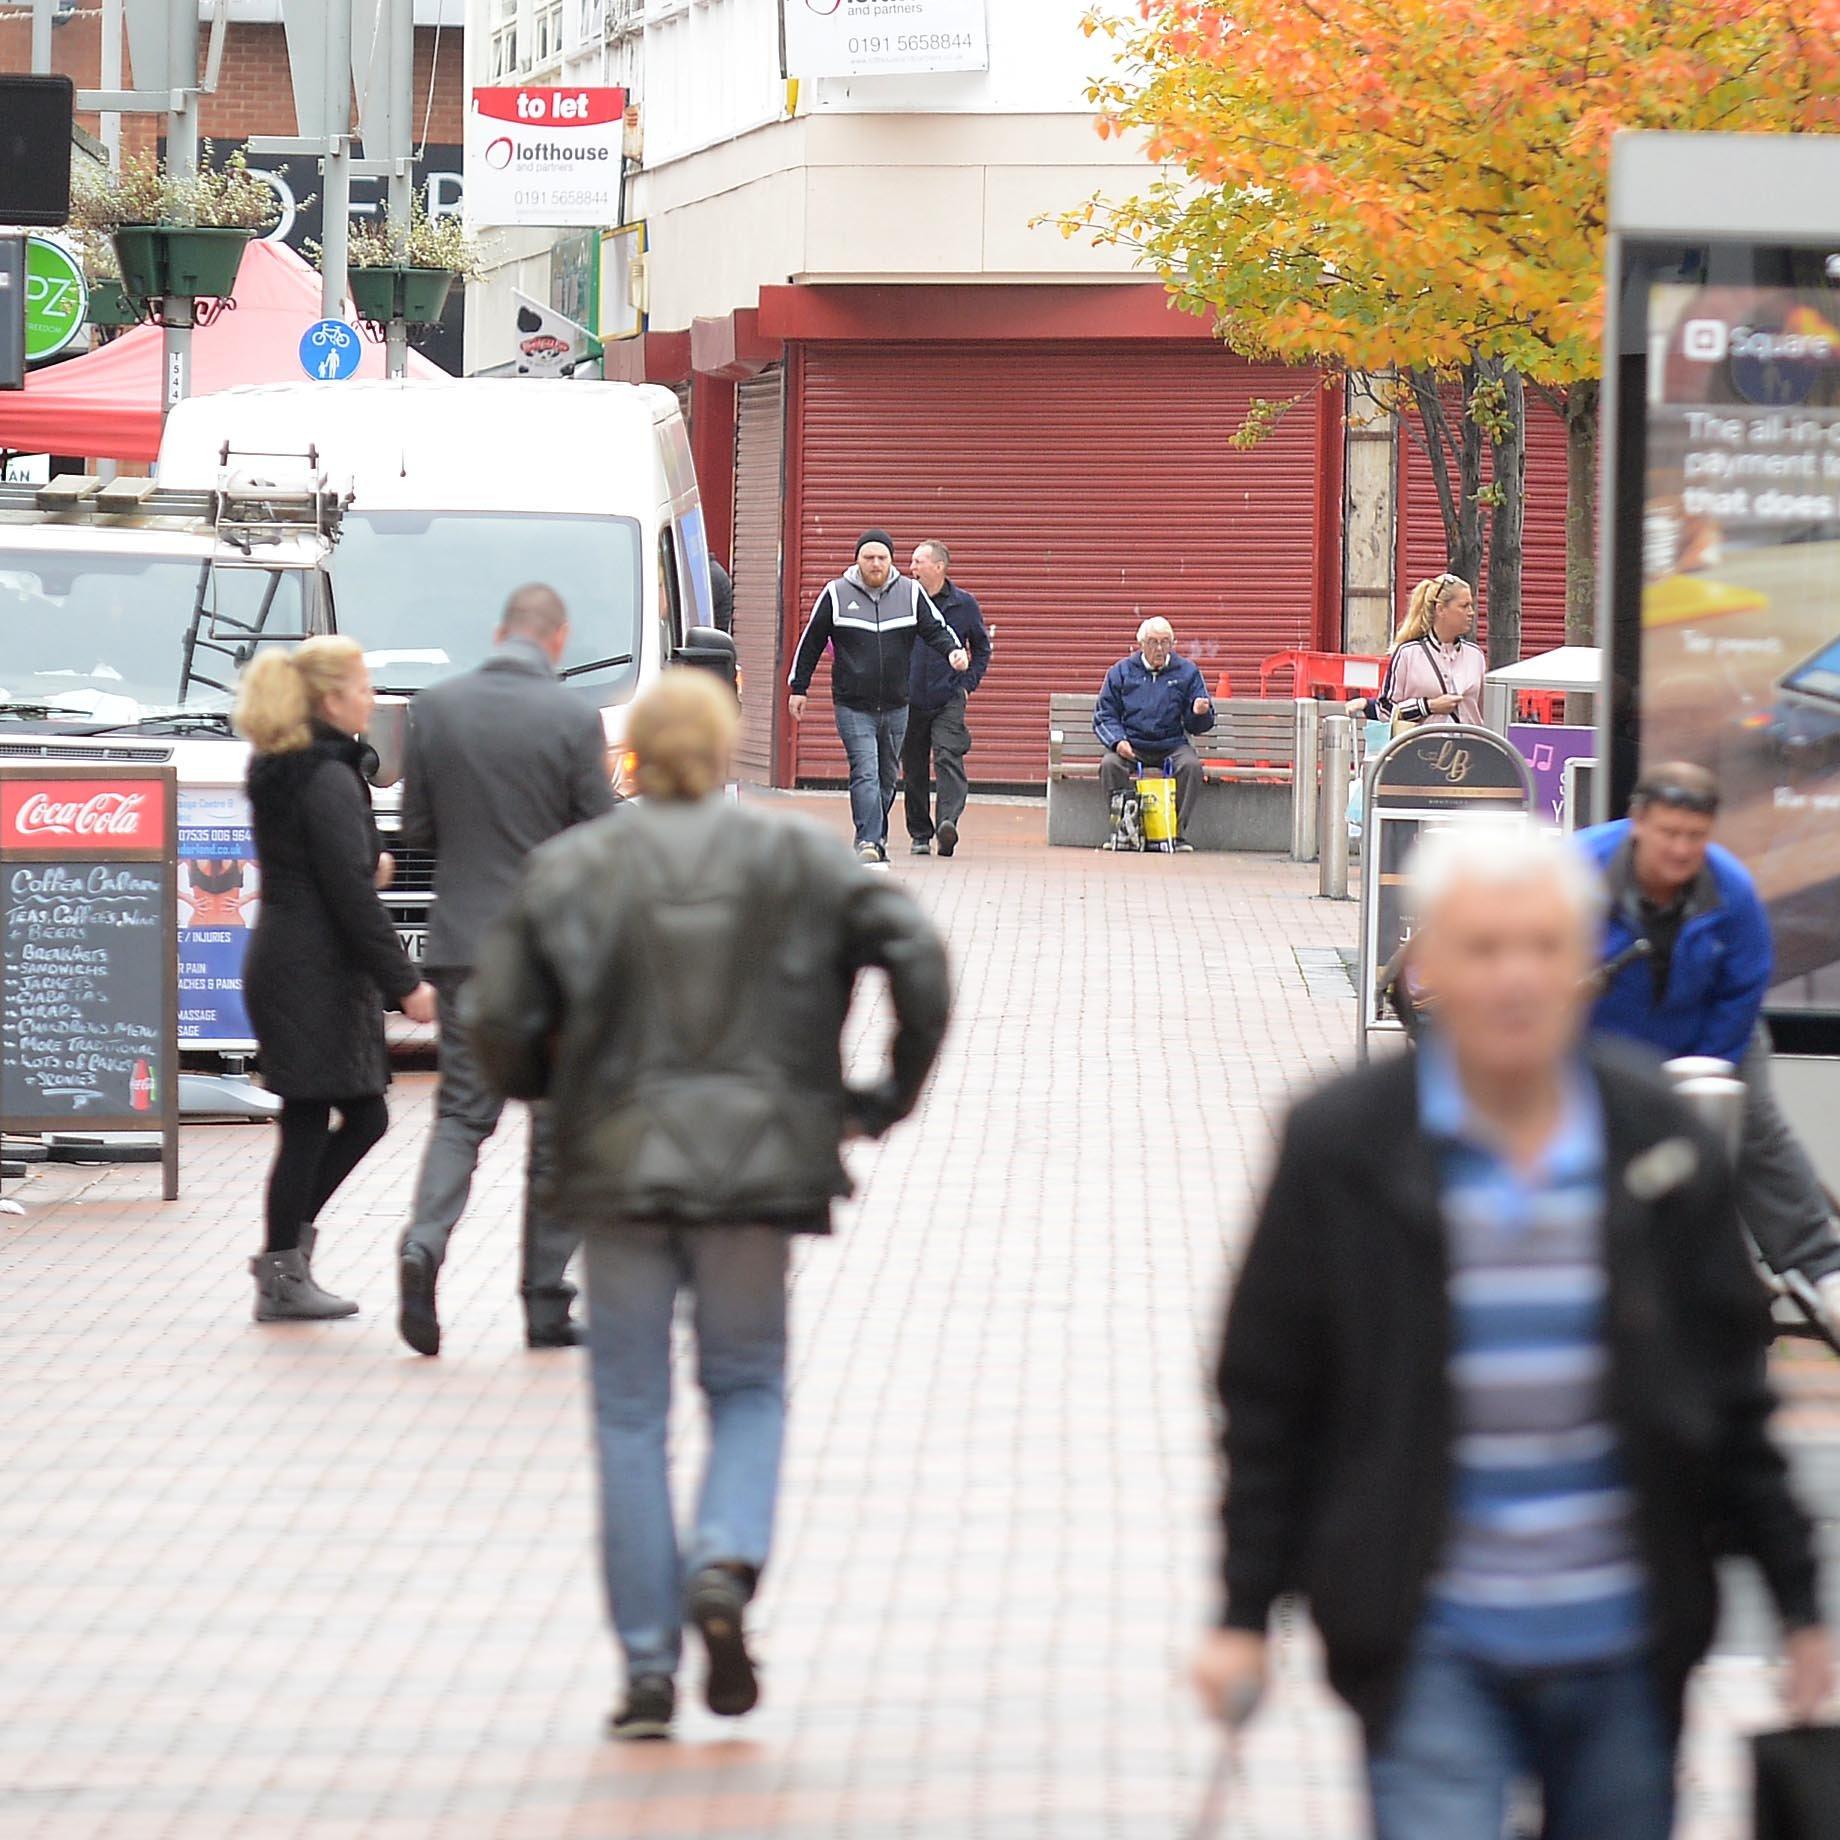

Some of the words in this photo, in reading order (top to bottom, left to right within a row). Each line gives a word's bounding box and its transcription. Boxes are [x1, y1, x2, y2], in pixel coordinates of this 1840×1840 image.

[848, 5, 871, 16] and
[873, 3, 923, 17] partners
[848, 36, 890, 54] 0191
[897, 33, 972, 52] 5658844
[516, 92, 546, 119] to
[551, 91, 589, 119] let
[516, 142, 609, 161] lofthouse
[514, 190, 546, 205] 0191
[551, 190, 608, 205] 5658844
[1729, 324, 1833, 359] Square
[1683, 412, 1742, 445] The
[1682, 449, 1817, 481] payment
[1682, 486, 1750, 516] that
[1754, 487, 1834, 519] does
[15, 792, 146, 835] Coca-Cola
[178, 829, 210, 842] 07535
[211, 829, 230, 842] 006
[232, 829, 251, 841] 964
[193, 931, 232, 943] INJURIES
[186, 964, 206, 975] PAIN
[216, 978, 242, 990] PAINS
[20, 1004, 82, 1018] WRAPS
